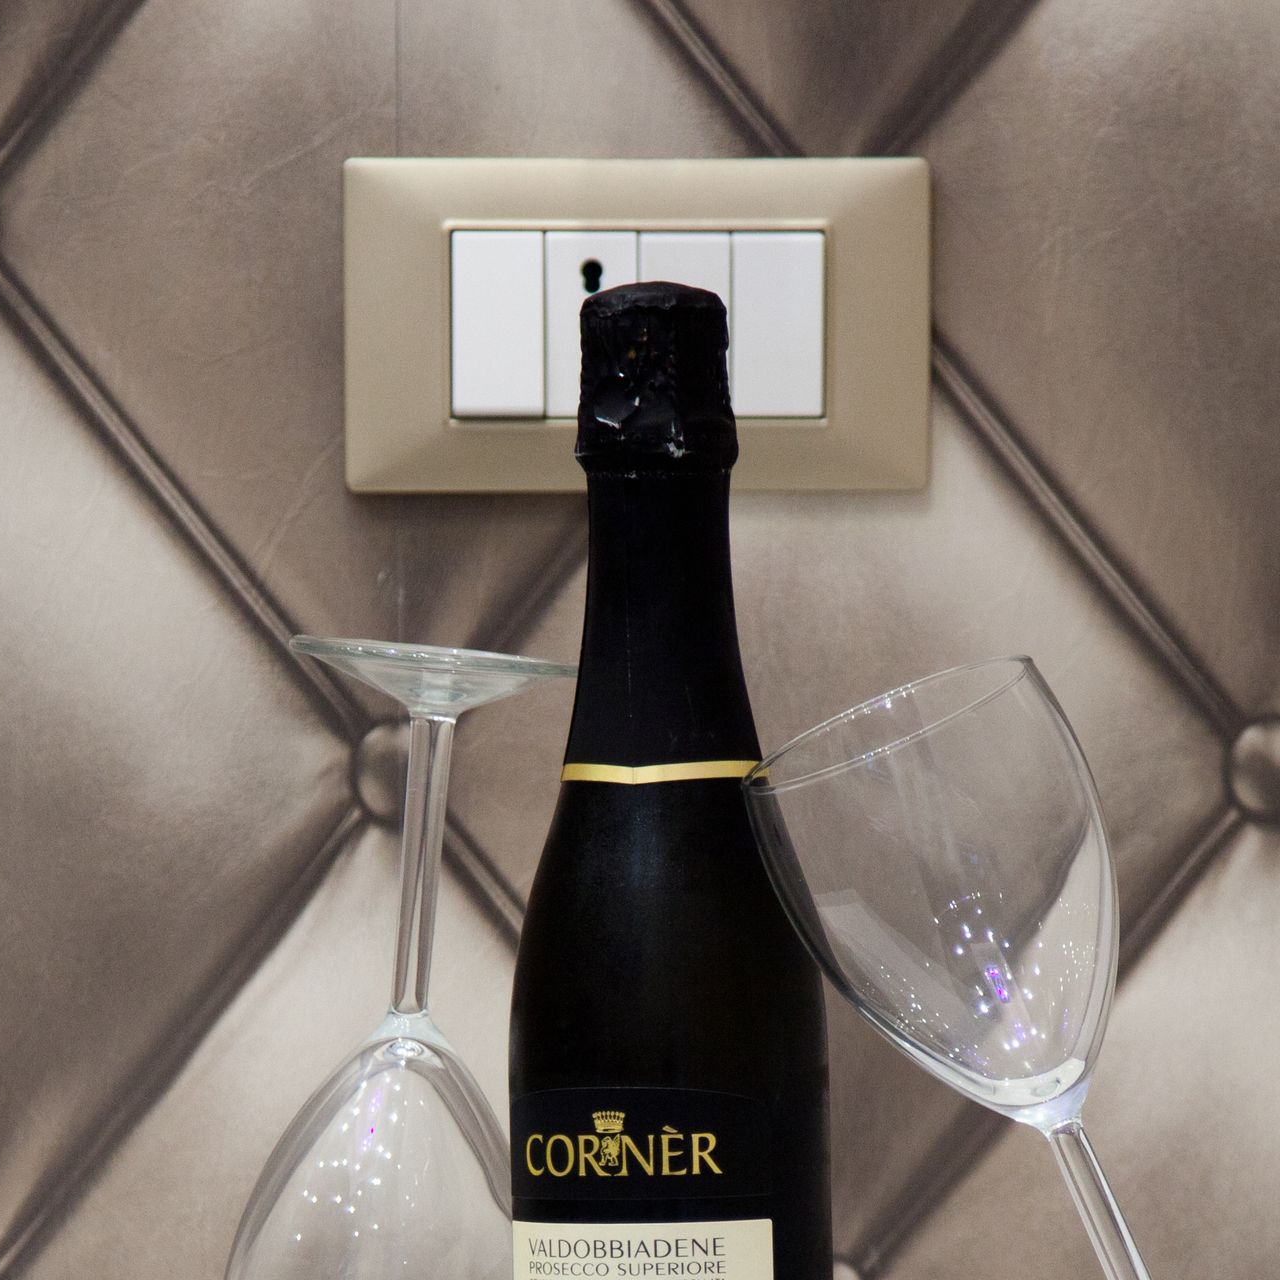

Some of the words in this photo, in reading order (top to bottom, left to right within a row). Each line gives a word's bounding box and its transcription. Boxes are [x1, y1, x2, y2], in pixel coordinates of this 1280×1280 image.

[528, 1237, 726, 1258] VALDOBBIADENE
[529, 1262, 609, 1276] PROSECCO
[617, 1260, 727, 1276] SUPERIORE
